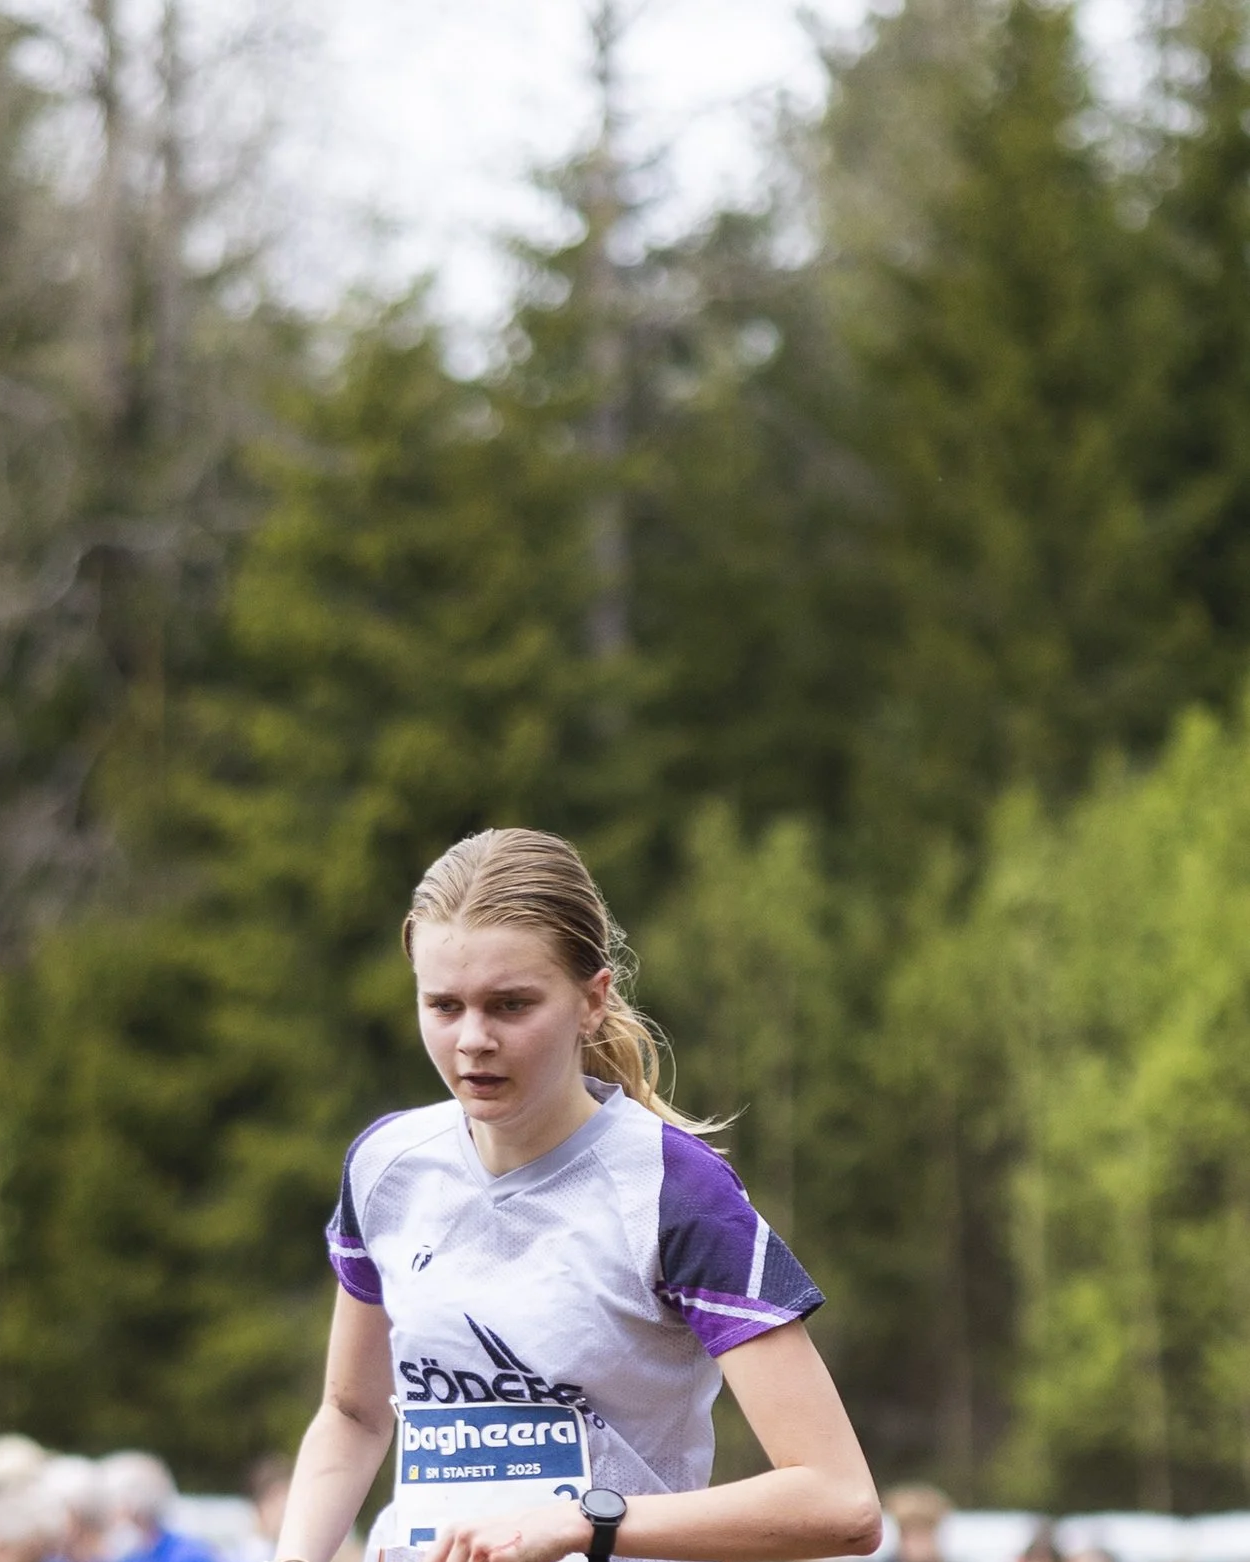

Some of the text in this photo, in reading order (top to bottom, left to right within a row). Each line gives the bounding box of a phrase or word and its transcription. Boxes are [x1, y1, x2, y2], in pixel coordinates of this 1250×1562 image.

[404, 1419, 578, 1456] bagheera
[442, 1465, 497, 1479] STAFETT
[506, 1463, 542, 1477] 2025
